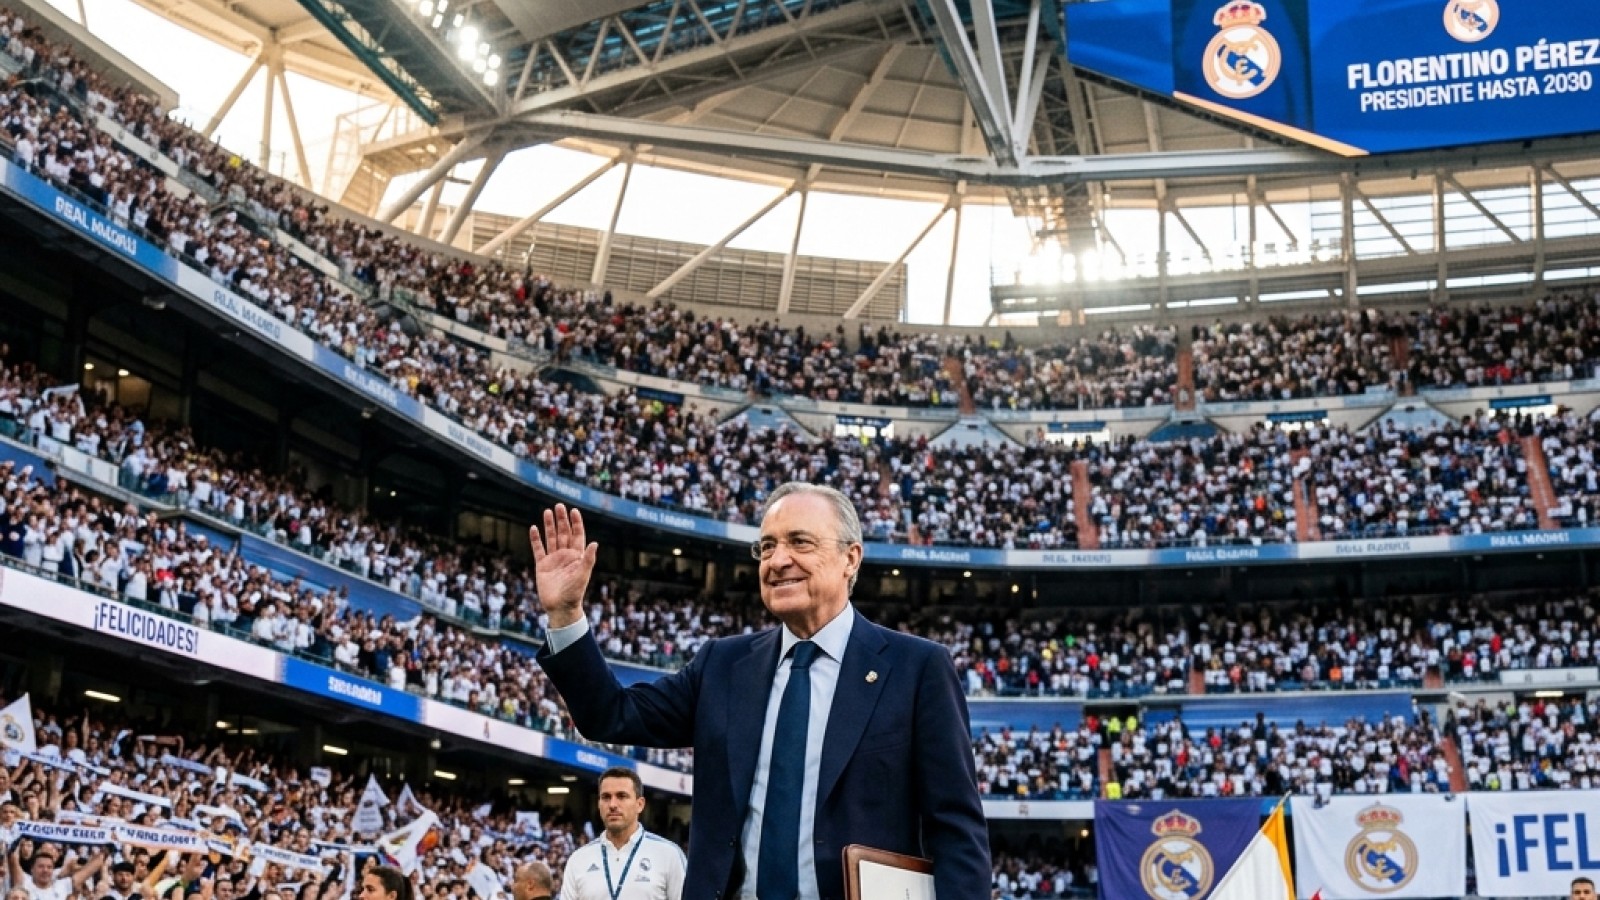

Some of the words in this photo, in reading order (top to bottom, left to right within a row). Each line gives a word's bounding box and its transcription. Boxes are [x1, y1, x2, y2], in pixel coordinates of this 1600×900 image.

[1347, 48, 1508, 90] FLORENTINO
[1515, 38, 1600, 72] PÉREZ
[1360, 82, 1474, 112] PRESIDENTE
[1477, 76, 1540, 101] HASTA
[1543, 70, 1592, 94] 2030
[1495, 812, 1600, 877] ¡FEL
